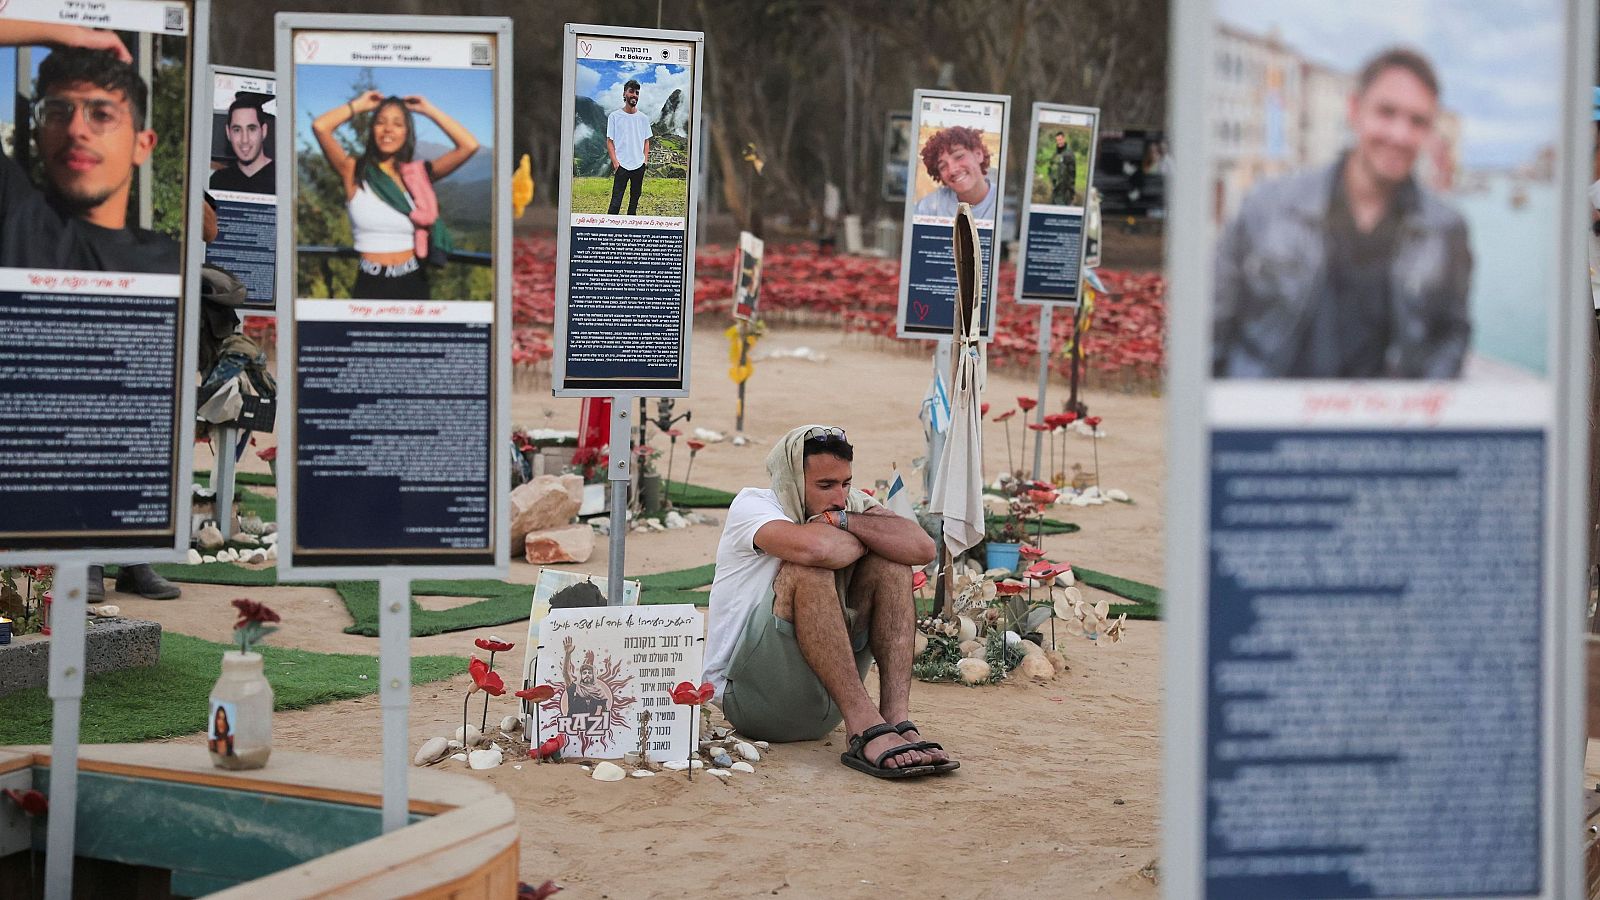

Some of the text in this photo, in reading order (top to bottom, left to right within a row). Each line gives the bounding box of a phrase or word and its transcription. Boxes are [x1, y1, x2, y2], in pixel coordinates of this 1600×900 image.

[595, 615, 606, 629] לא
[606, 619, 623, 630] אחד
[624, 636, 656, 650] בוקובזה
[684, 635, 693, 647] רז
[633, 652, 683, 663] מלך העולם שלנו
[639, 667, 676, 678] המון מאיתנו
[640, 682, 656, 693] איתך
[641, 697, 670, 708] המון ממך
[655, 711, 676, 722] ממשיך
[557, 711, 610, 736] RAZI
[655, 726, 671, 736] נזכור
[652, 741, 671, 751] ונאהב
